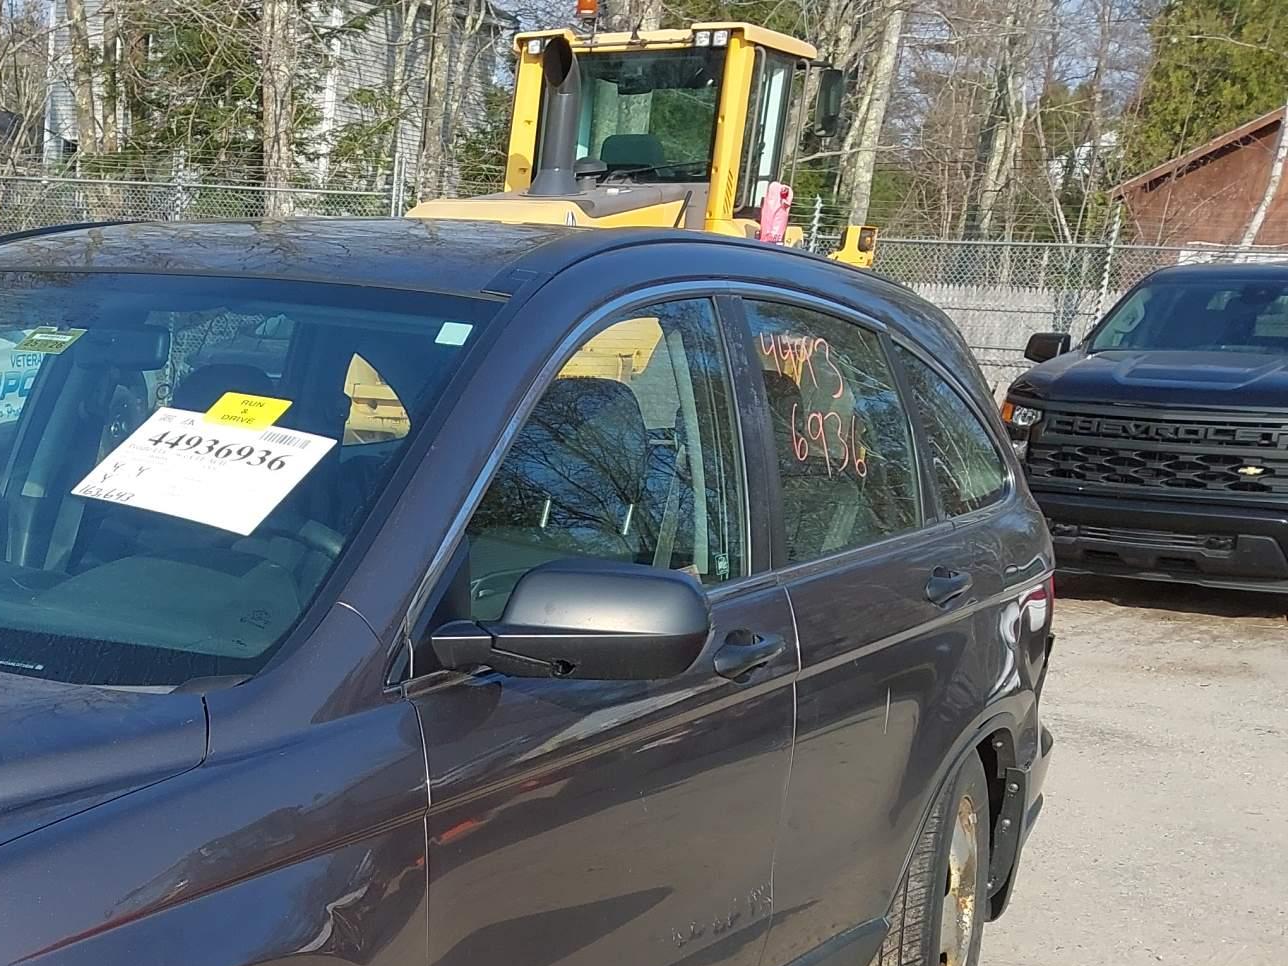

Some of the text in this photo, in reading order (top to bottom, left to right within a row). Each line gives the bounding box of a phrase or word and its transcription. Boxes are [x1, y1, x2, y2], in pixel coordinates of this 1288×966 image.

[759, 331, 844, 399] 4493
[221, 413, 256, 425] DRIVE
[240, 399, 265, 408] RUN
[791, 402, 867, 479] 6936
[1048, 416, 1288, 447] CHEVROLET
[148, 431, 294, 471] 44936936
